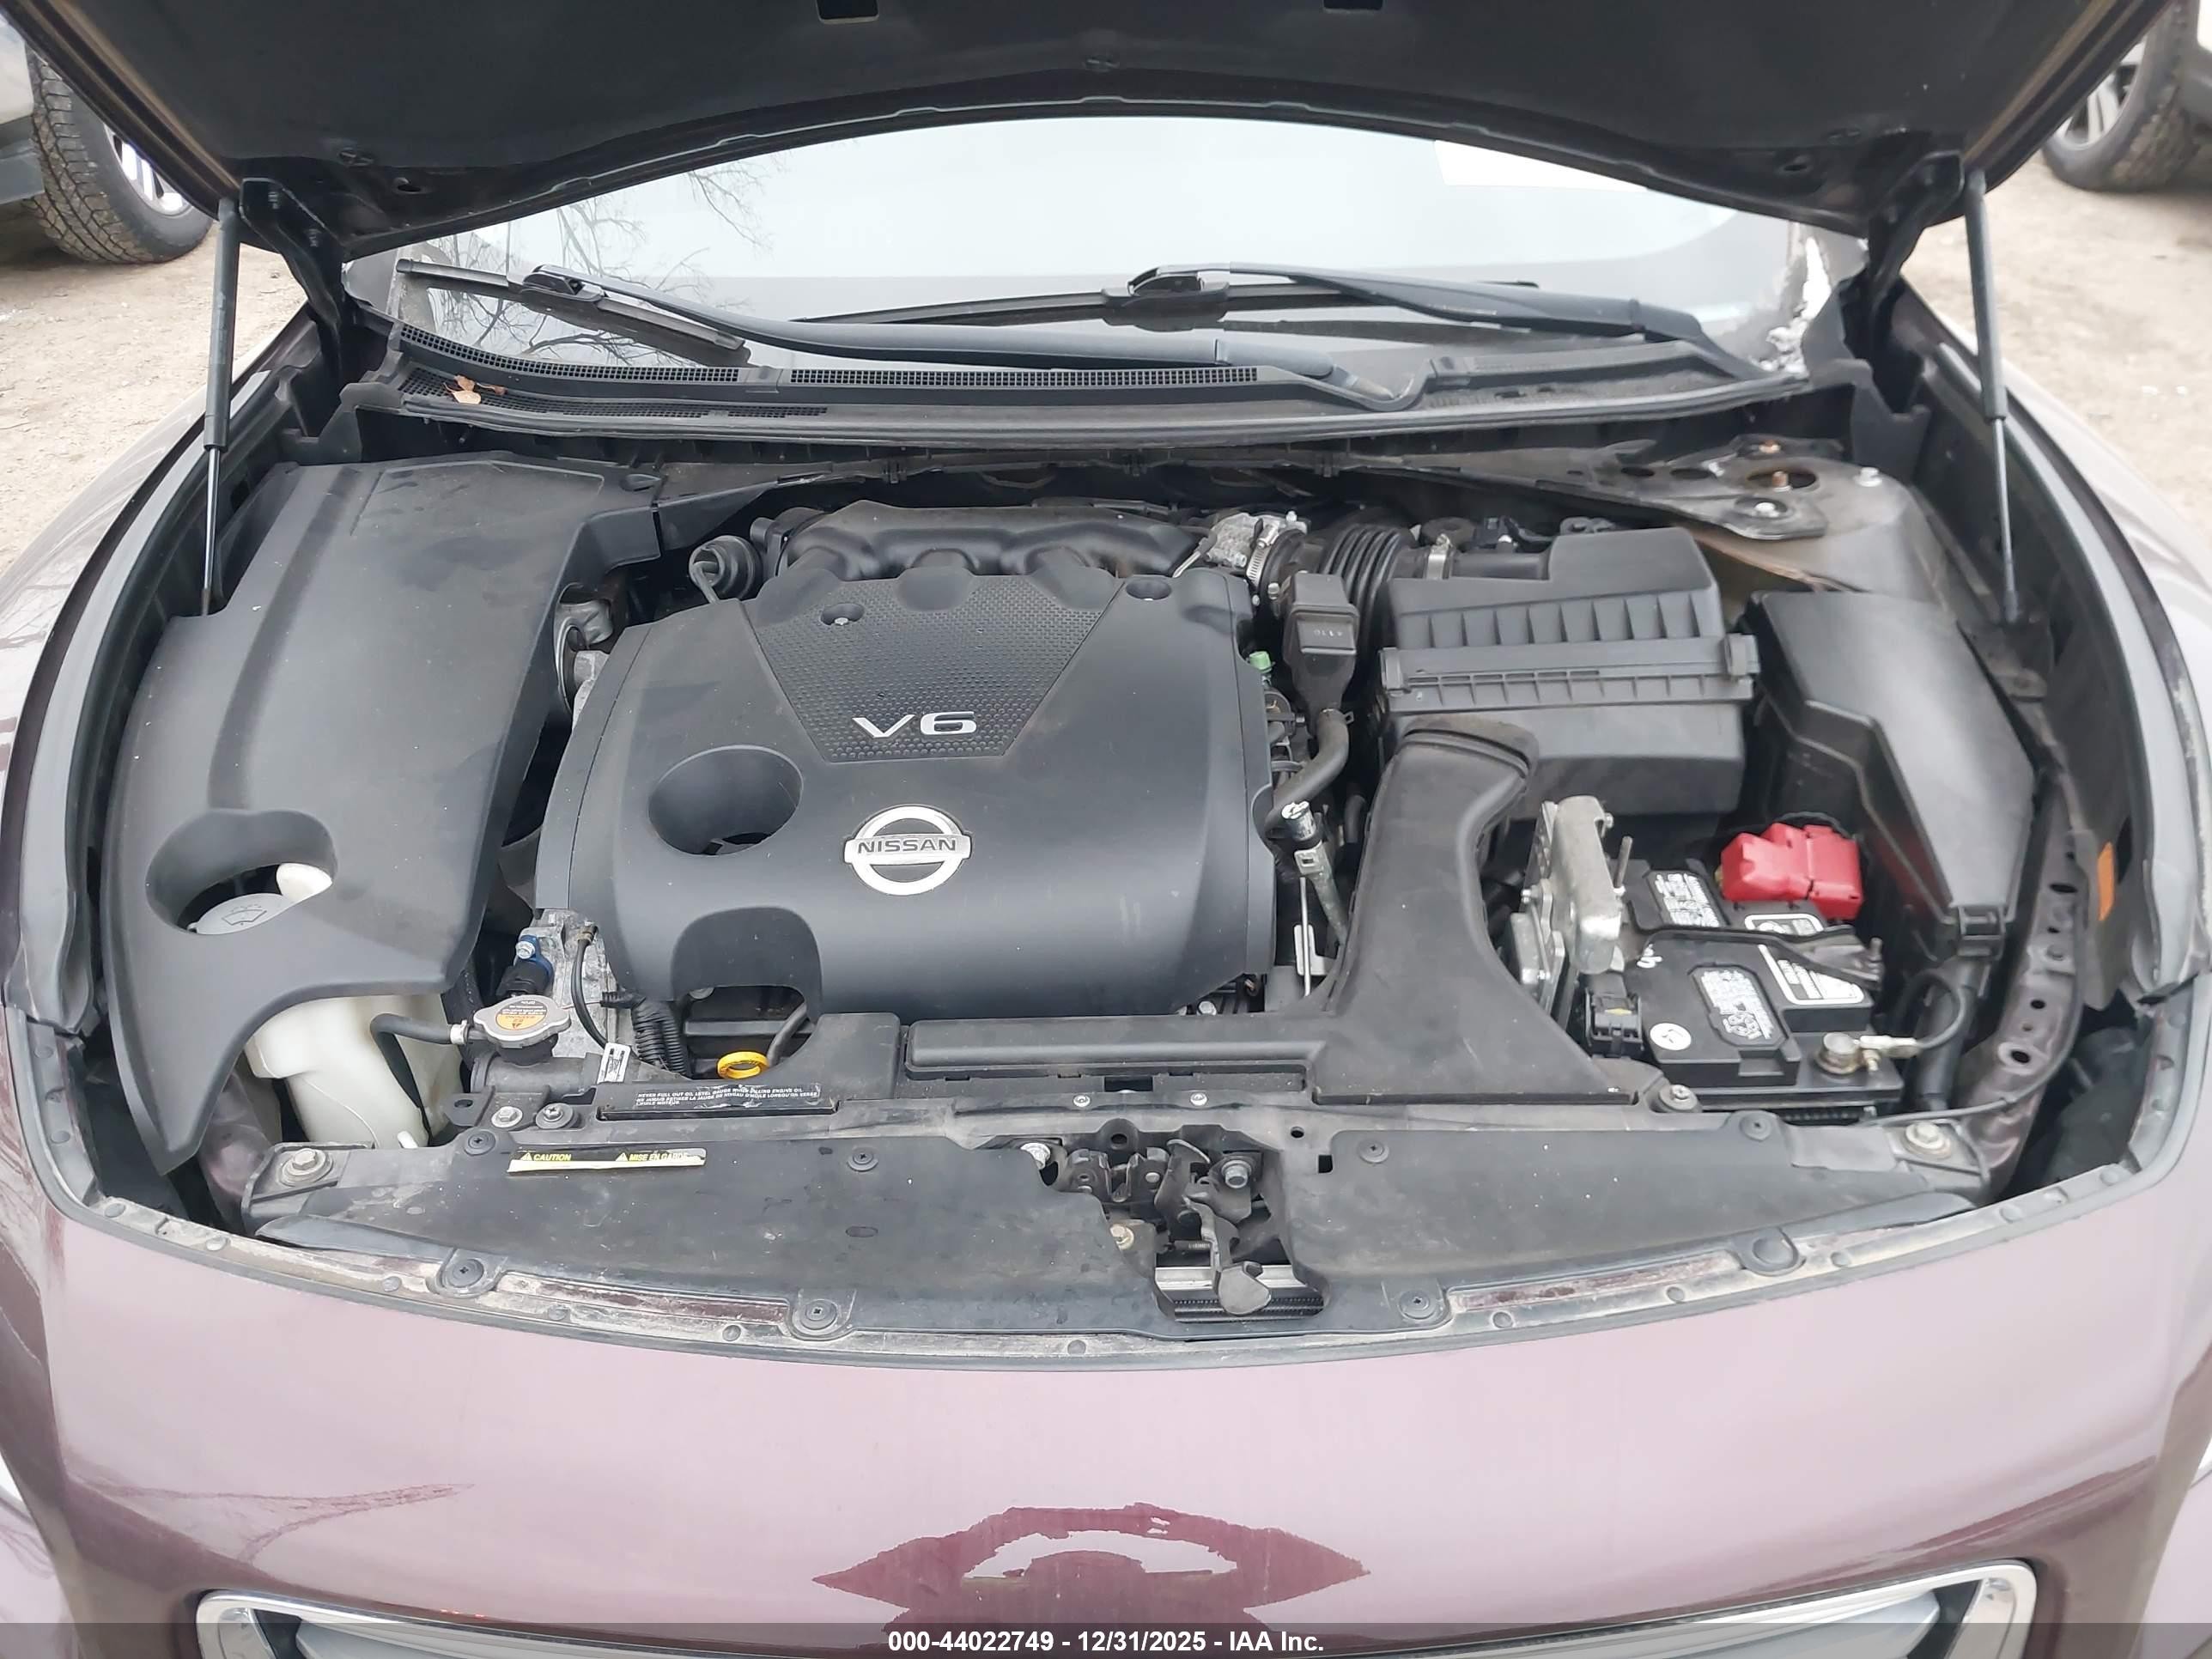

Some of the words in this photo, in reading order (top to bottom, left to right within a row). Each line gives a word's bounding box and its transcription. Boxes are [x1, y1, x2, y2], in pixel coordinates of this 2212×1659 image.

[852, 711, 977, 738] V6
[858, 838, 957, 854] NISSAN
[533, 1153, 572, 1162] CAUTION
[629, 1153, 648, 1162] MISE
